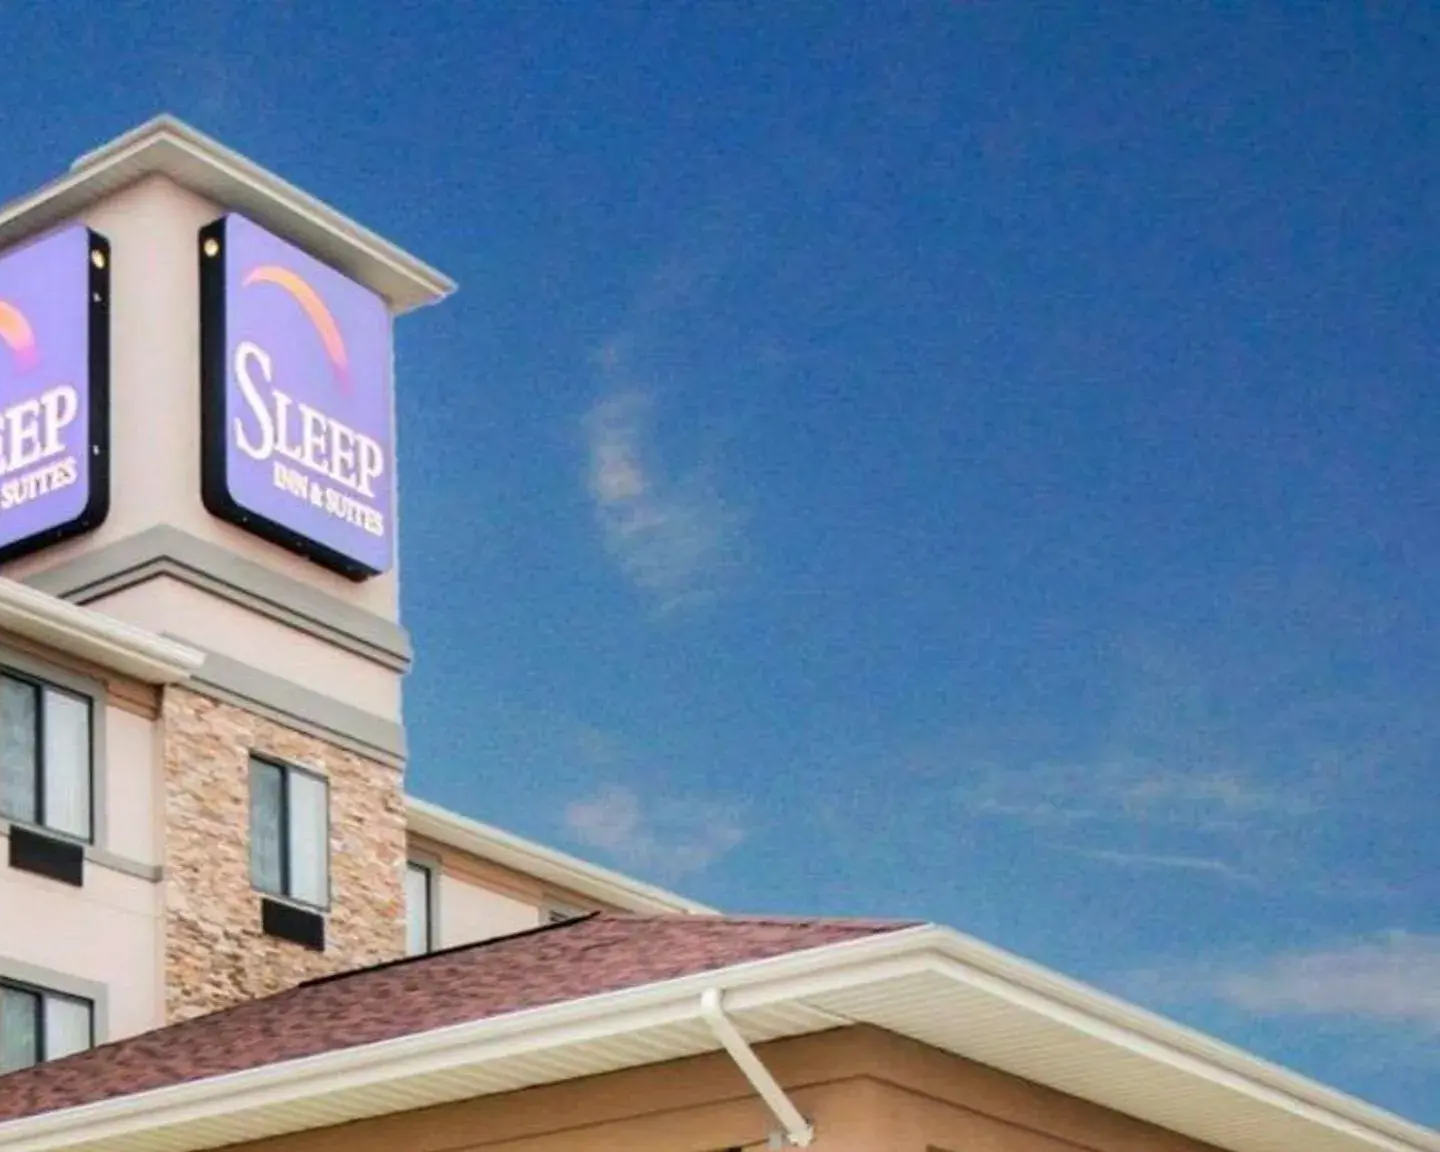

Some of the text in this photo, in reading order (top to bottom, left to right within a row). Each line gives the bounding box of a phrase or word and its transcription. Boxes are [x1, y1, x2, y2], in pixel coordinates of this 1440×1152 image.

[234, 341, 383, 498] SLEEP
[0, 457, 77, 508] SUITES
[273, 461, 384, 536] INN & SUITES
